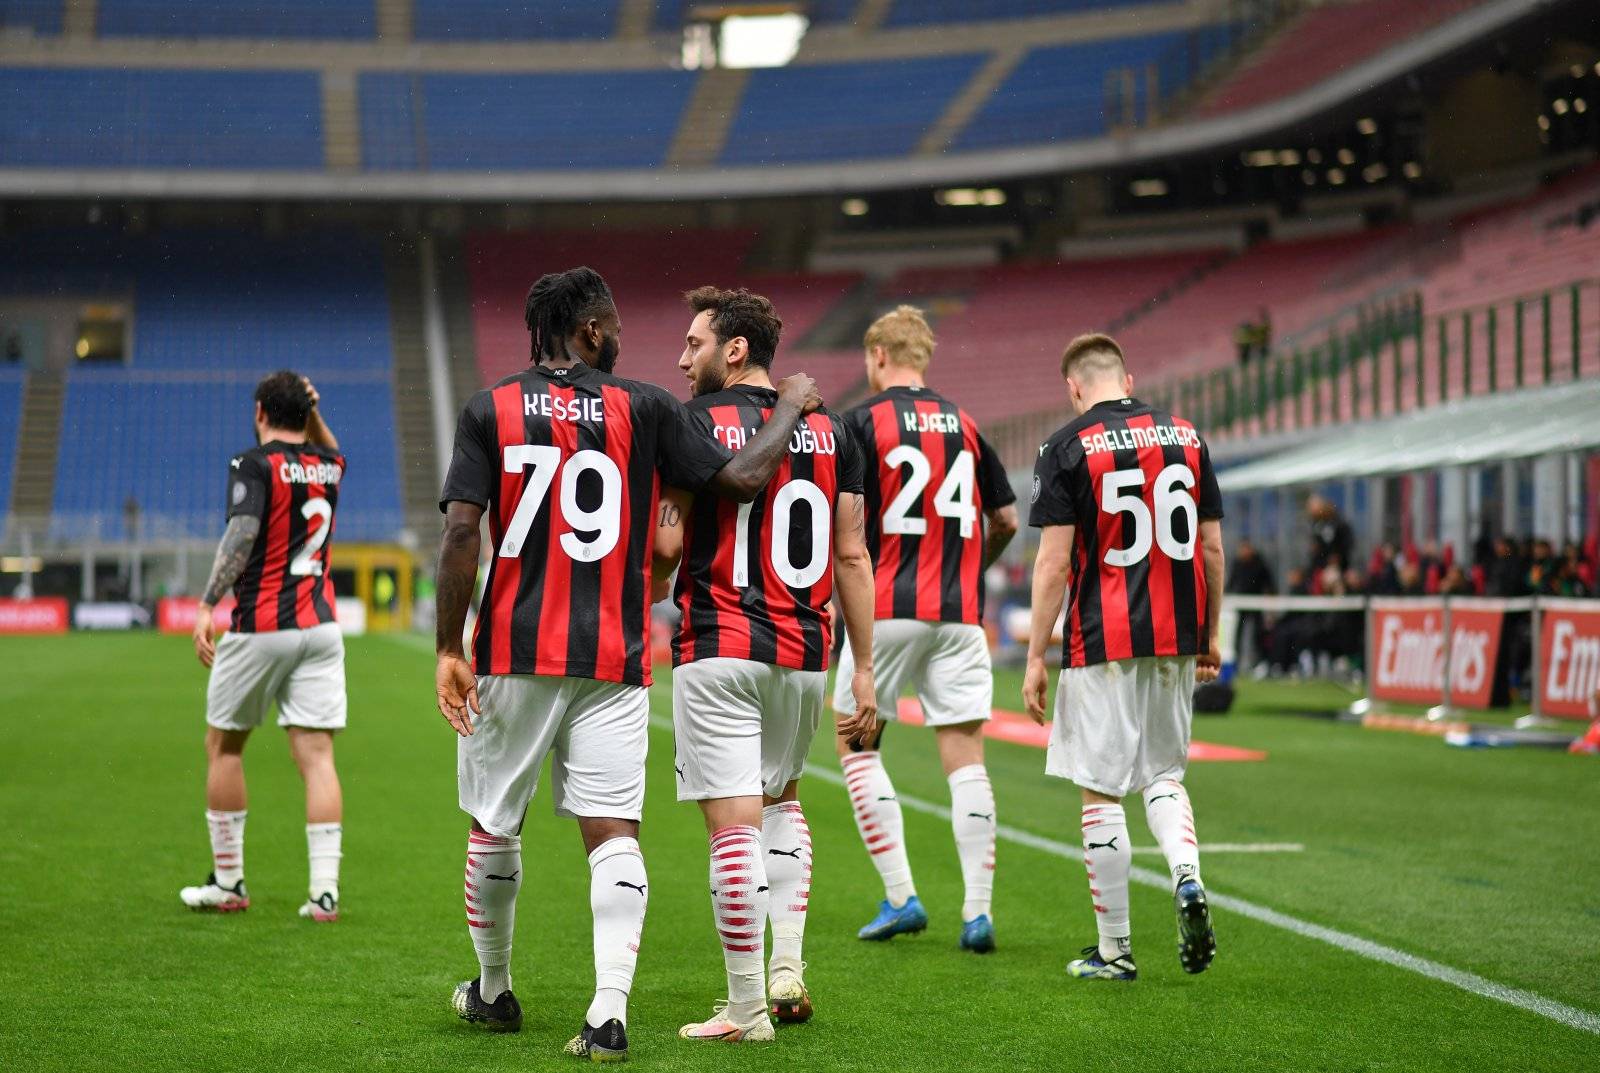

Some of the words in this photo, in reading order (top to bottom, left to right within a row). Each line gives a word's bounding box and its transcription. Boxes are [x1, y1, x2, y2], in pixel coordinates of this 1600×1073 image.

[524, 393, 605, 422] KESSIE
[903, 411, 959, 434] KJÆR
[1081, 425, 1201, 456] SAELEMAEKERS
[499, 444, 623, 563] 79
[659, 503, 682, 529] 10
[882, 445, 977, 539] 24
[1101, 463, 1199, 567] 56
[290, 497, 333, 576] 2
[732, 479, 831, 589] 10
